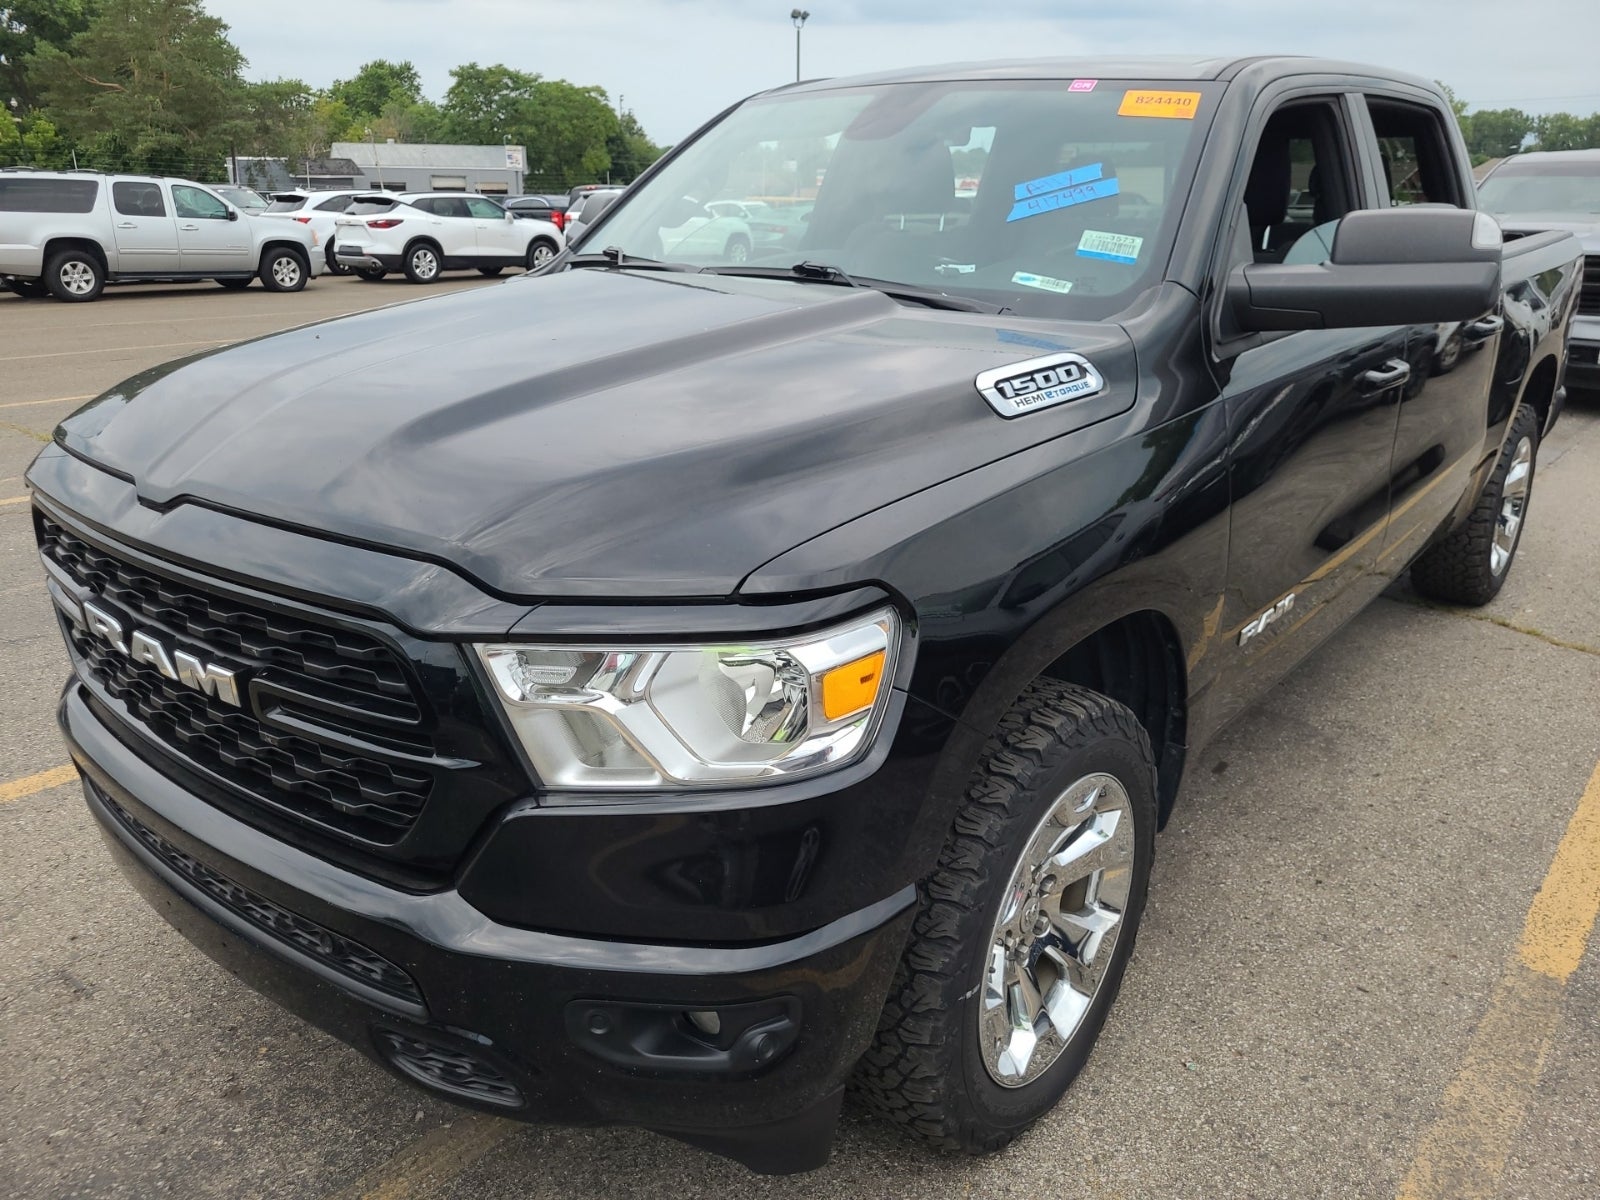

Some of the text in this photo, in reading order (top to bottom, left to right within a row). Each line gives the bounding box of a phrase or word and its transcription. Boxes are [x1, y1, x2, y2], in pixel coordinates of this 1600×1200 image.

[1135, 96, 1192, 106] 824440
[998, 364, 1081, 398] 1500
[1014, 394, 1046, 408] HEMI
[84, 600, 241, 708] RAM
